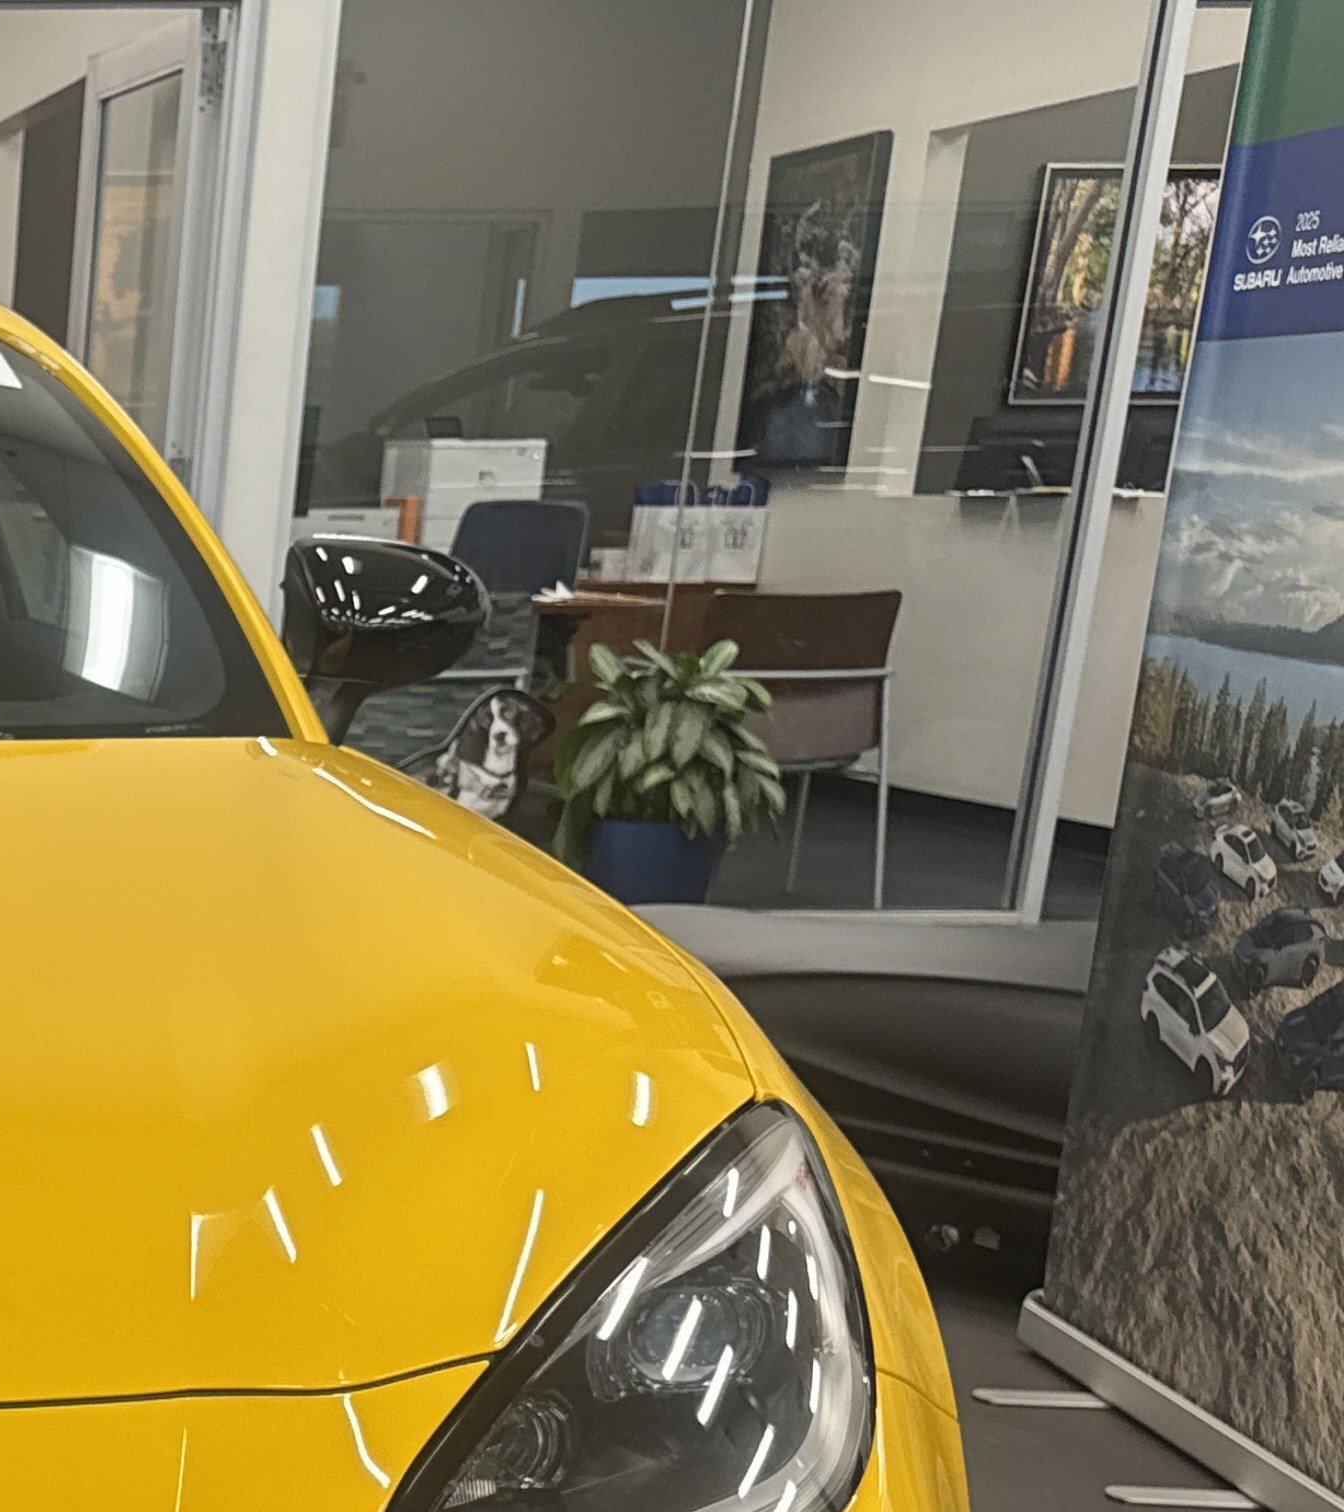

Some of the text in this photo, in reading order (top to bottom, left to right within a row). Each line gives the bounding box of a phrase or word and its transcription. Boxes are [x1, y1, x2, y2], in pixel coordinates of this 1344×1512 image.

[1295, 210, 1321, 232] 2025
[1291, 239, 1318, 258] Most
[1233, 268, 1282, 292] SUBARU
[1286, 261, 1344, 285] Automotive
